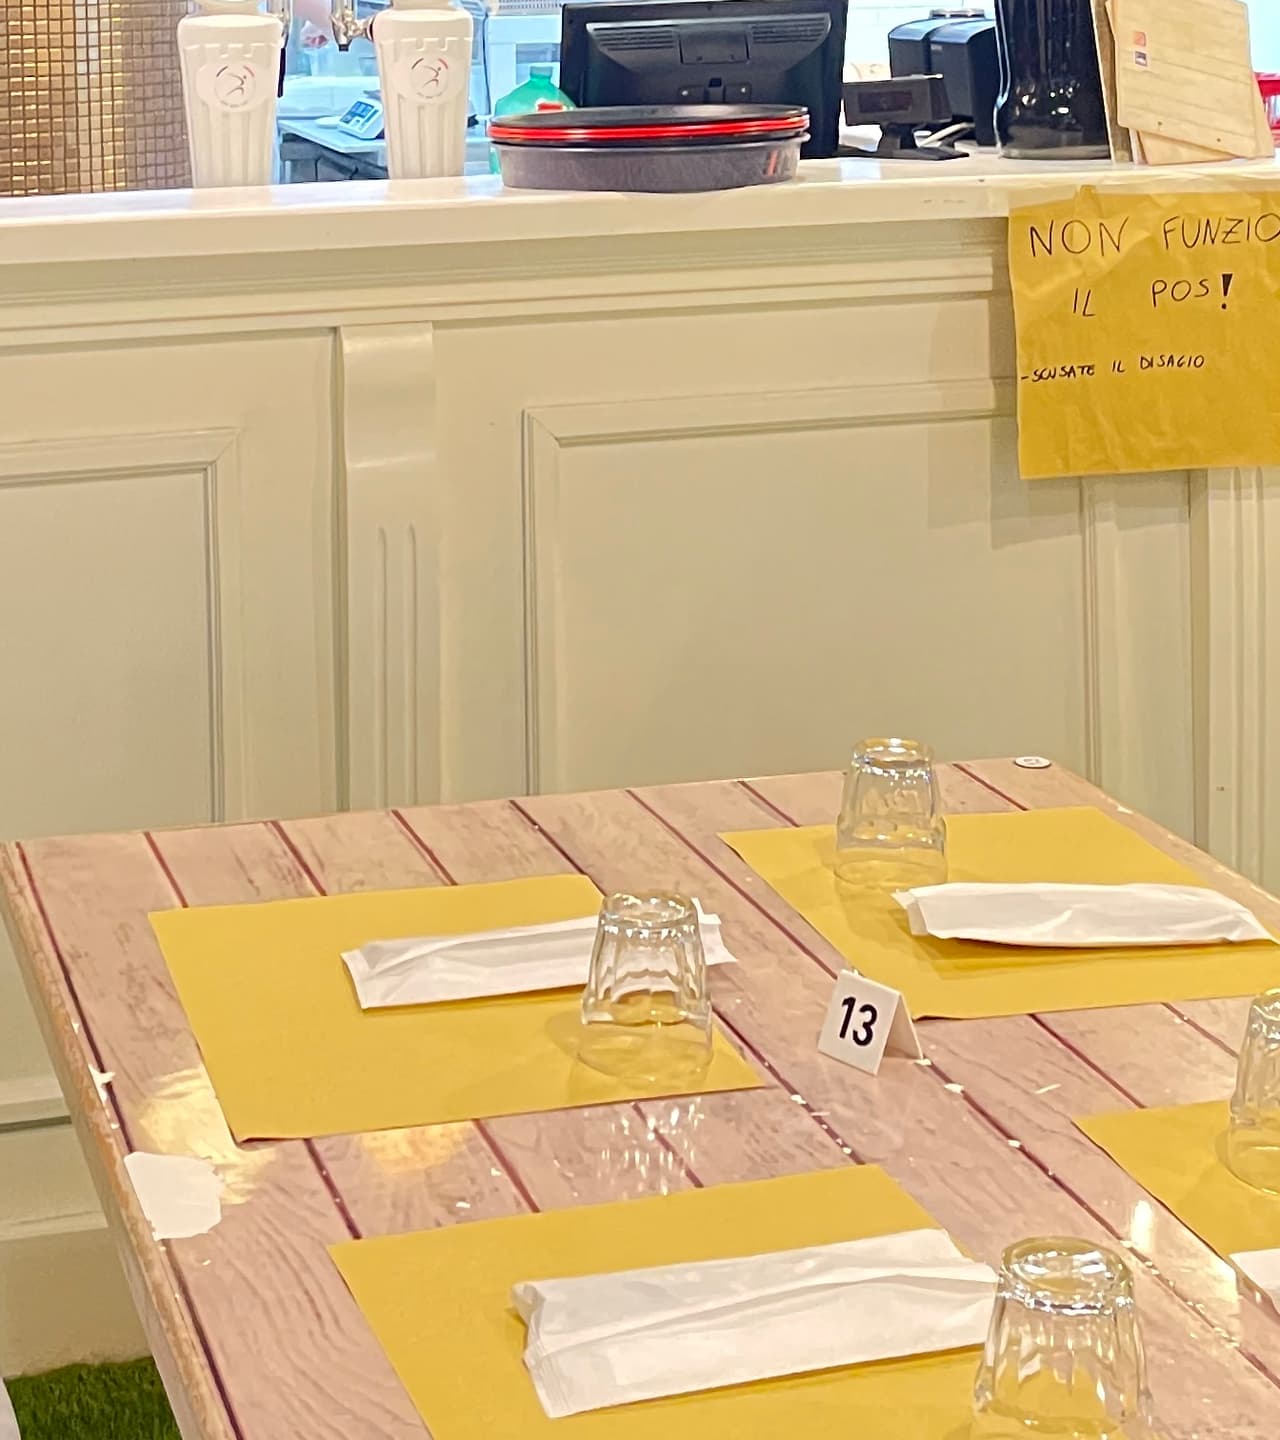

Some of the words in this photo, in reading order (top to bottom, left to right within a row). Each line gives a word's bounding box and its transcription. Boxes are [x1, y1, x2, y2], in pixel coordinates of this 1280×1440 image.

[1030, 216, 1128, 257] NON
[1073, 287, 1096, 317] IL
[1112, 360, 1125, 372] IL
[1140, 354, 1205, 370] DISAGIO
[839, 996, 878, 1046] 13
